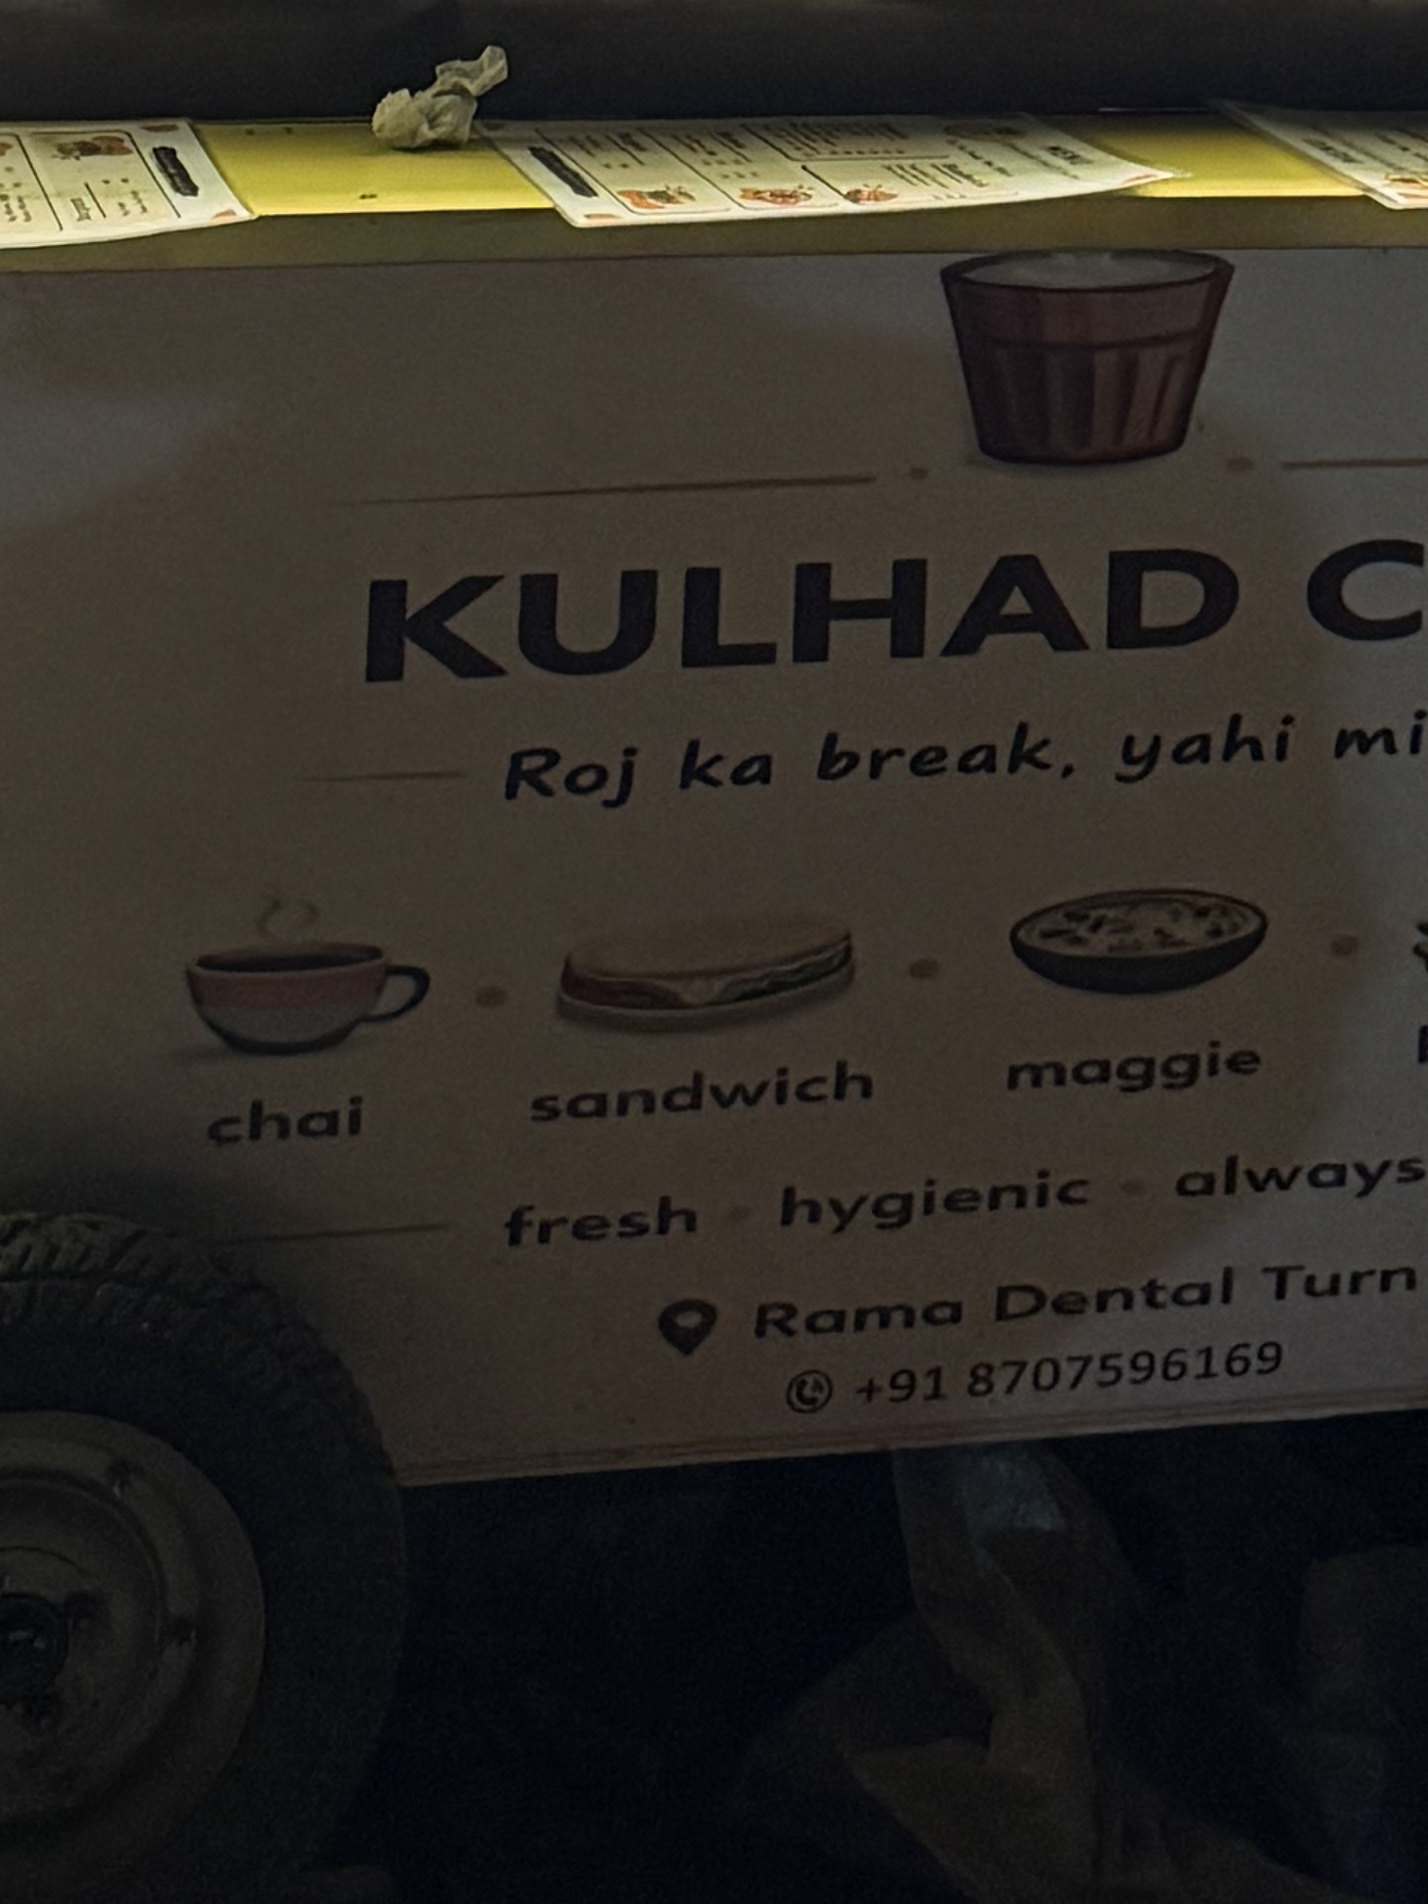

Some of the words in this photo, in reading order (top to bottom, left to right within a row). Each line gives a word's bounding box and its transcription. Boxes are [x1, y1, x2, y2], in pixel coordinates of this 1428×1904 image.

[366, 549, 1240, 682] KULHAD
[505, 747, 638, 809] Roj
[679, 740, 772, 790] ka
[818, 723, 1075, 780] break,
[1115, 714, 1294, 783] yahi
[531, 1061, 874, 1123] sandwich
[1006, 1040, 1261, 1093] maggie
[207, 1097, 364, 1146] chai
[505, 1198, 698, 1246] fresh
[781, 1169, 1091, 1235] hygienic
[1175, 1155, 1427, 1197] always
[755, 1297, 963, 1339] Rama
[994, 1266, 1233, 1323] Dental
[1263, 1263, 1418, 1303] Turn
[856, 1365, 948, 1405] +91
[967, 1340, 1284, 1397] 8707596169
